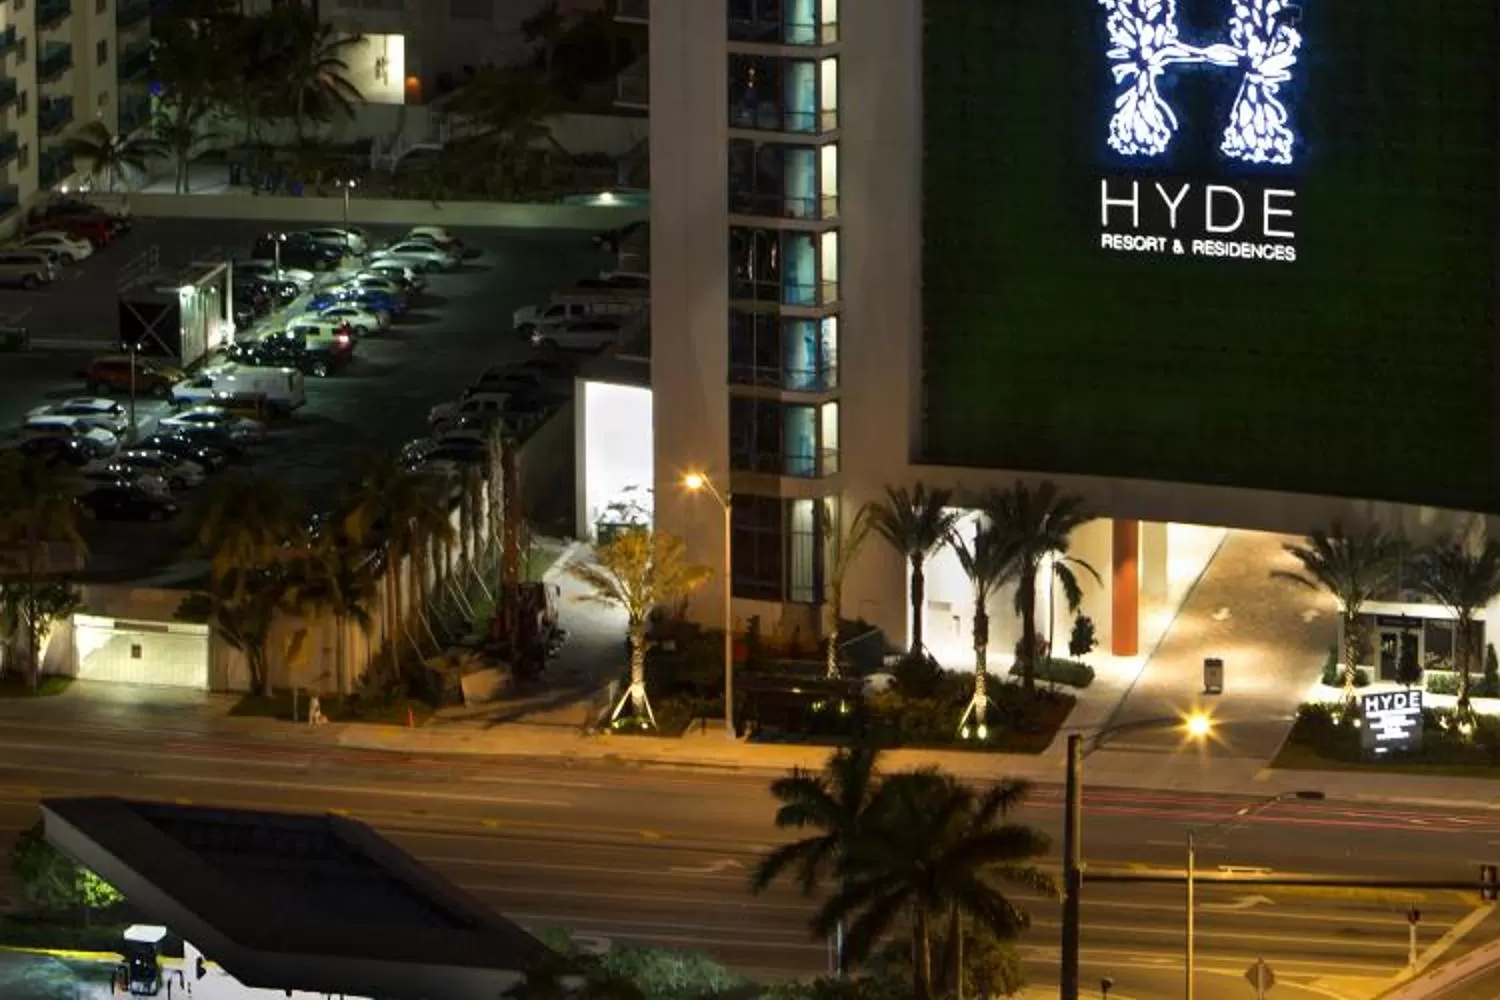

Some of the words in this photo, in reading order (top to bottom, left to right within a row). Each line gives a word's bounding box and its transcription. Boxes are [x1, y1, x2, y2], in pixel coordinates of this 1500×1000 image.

[1100, 178, 1297, 238] HYDE
[1101, 233, 1167, 252] RESORT
[1172, 237, 1185, 254] &
[1192, 239, 1297, 262] RESIDENCES
[1365, 691, 1420, 711] HYDE
